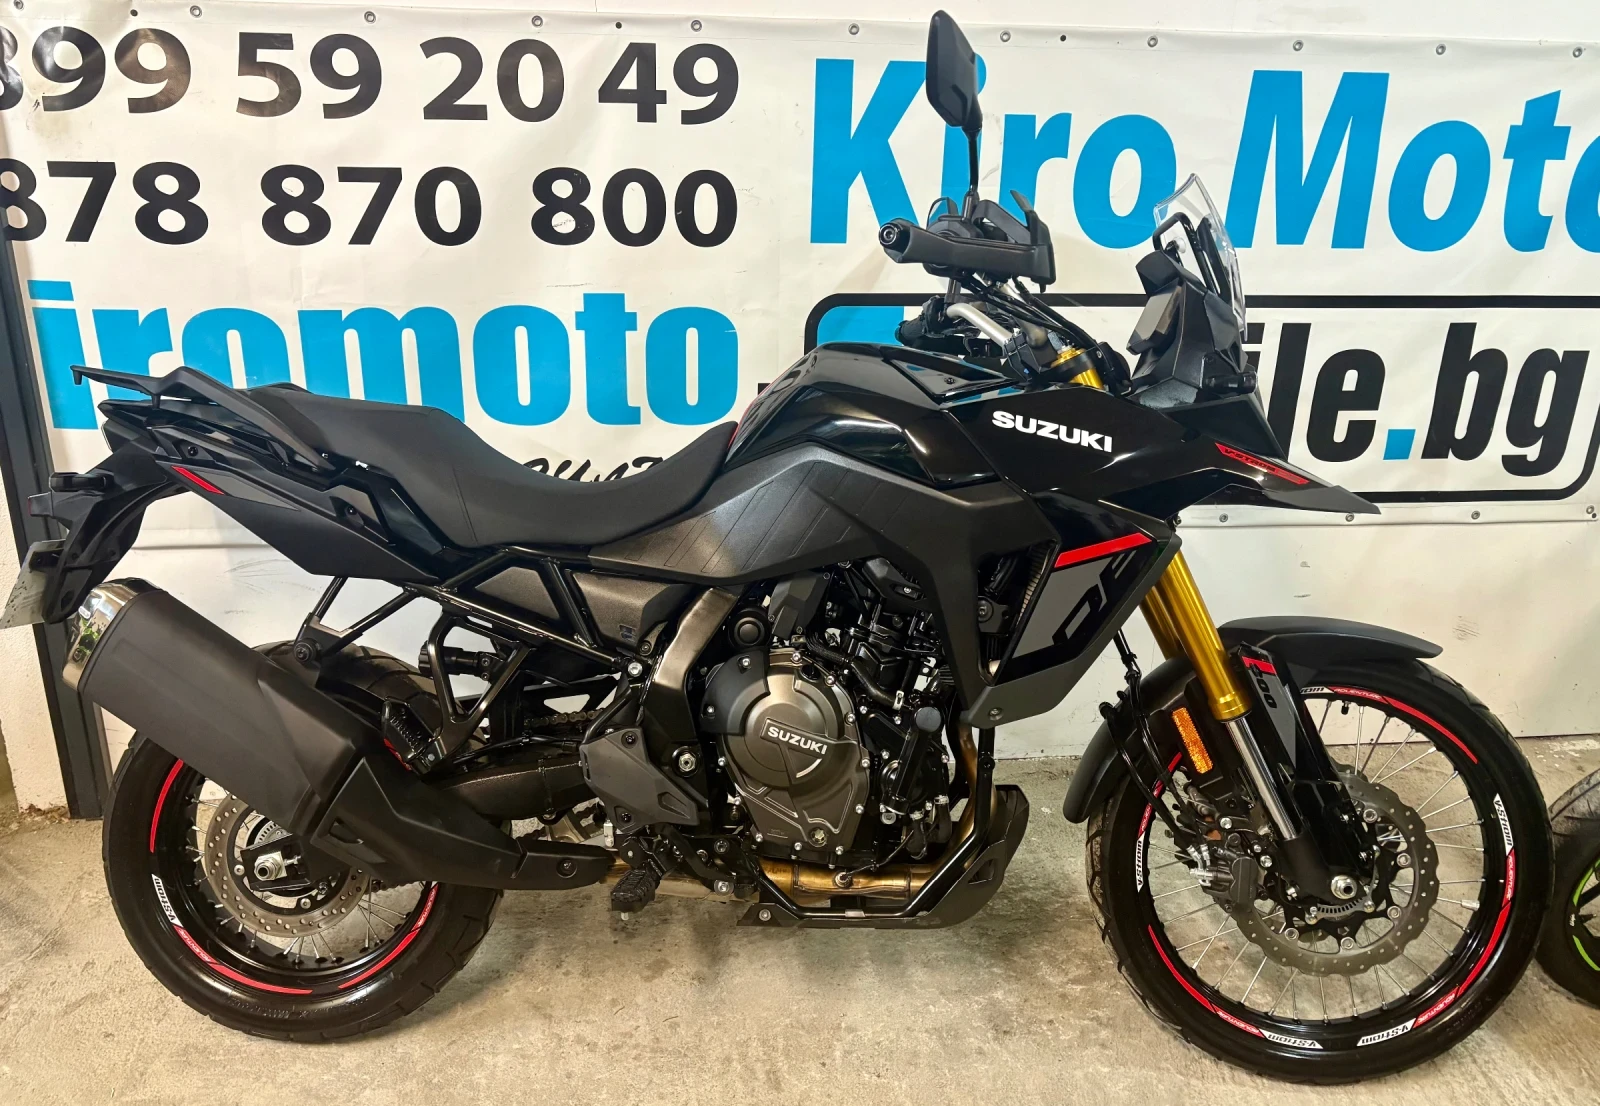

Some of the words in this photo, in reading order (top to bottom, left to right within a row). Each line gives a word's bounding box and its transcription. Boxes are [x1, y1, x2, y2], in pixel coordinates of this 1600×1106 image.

[236, 31, 382, 119] 59
[419, 36, 564, 122] 20
[598, 42, 739, 125] 49
[0, 158, 208, 245] 878
[260, 164, 482, 246] 870
[531, 167, 738, 248] 800
[991, 410, 1113, 453] SUZUKI
[767, 726, 828, 755] SUZUKI
